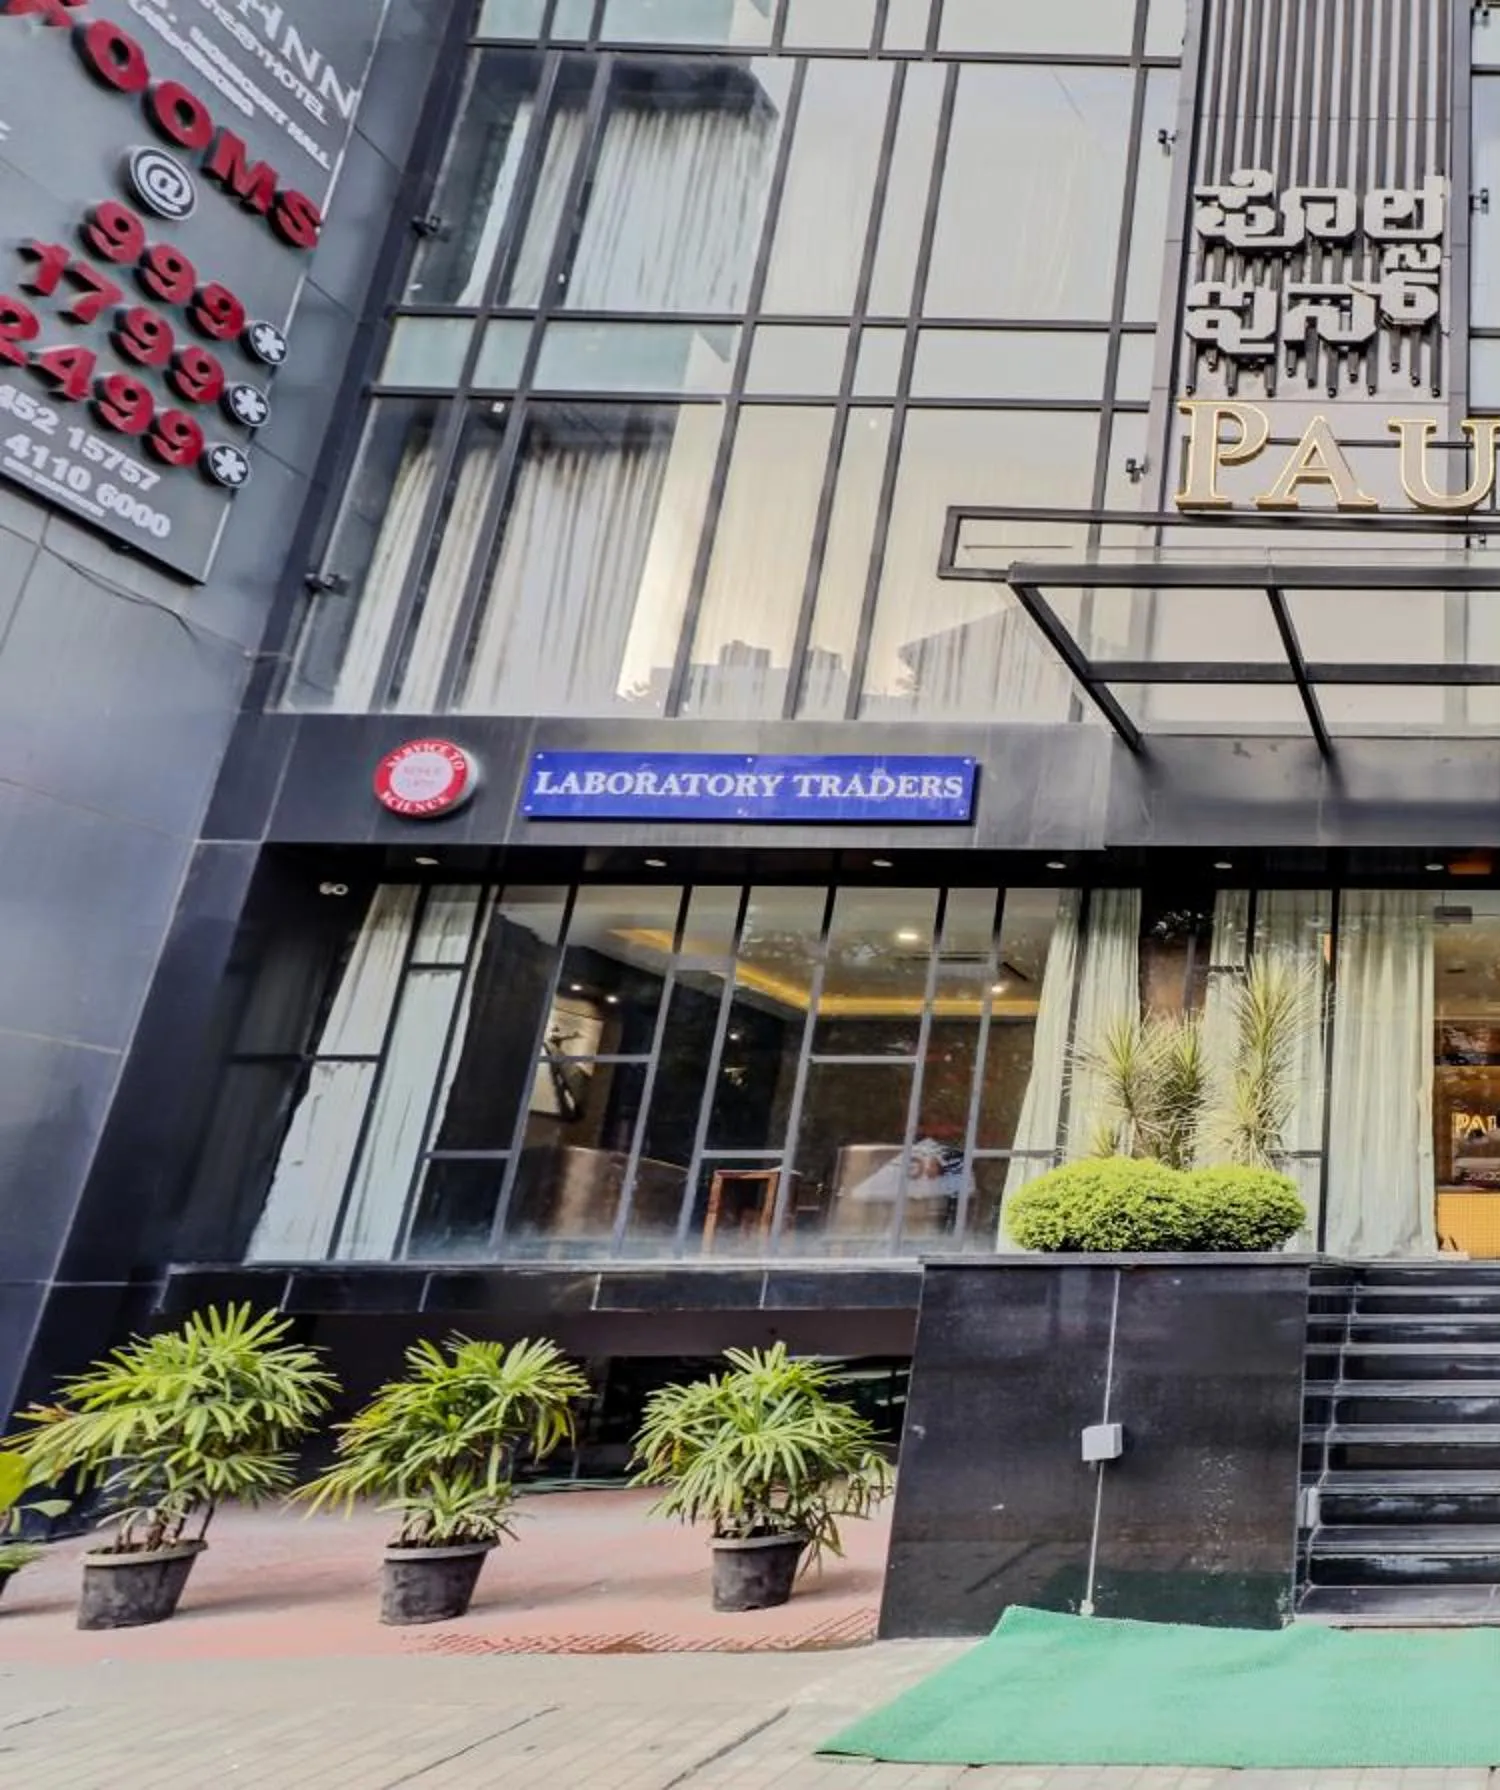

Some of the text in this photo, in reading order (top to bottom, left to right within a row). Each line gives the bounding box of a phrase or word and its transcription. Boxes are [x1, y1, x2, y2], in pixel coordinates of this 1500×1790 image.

[3, 432, 92, 493] 4110
[95, 482, 172, 539] 6000
[67, 426, 161, 491] 15757
[533, 769, 964, 800] LABORATORY TRADERS
